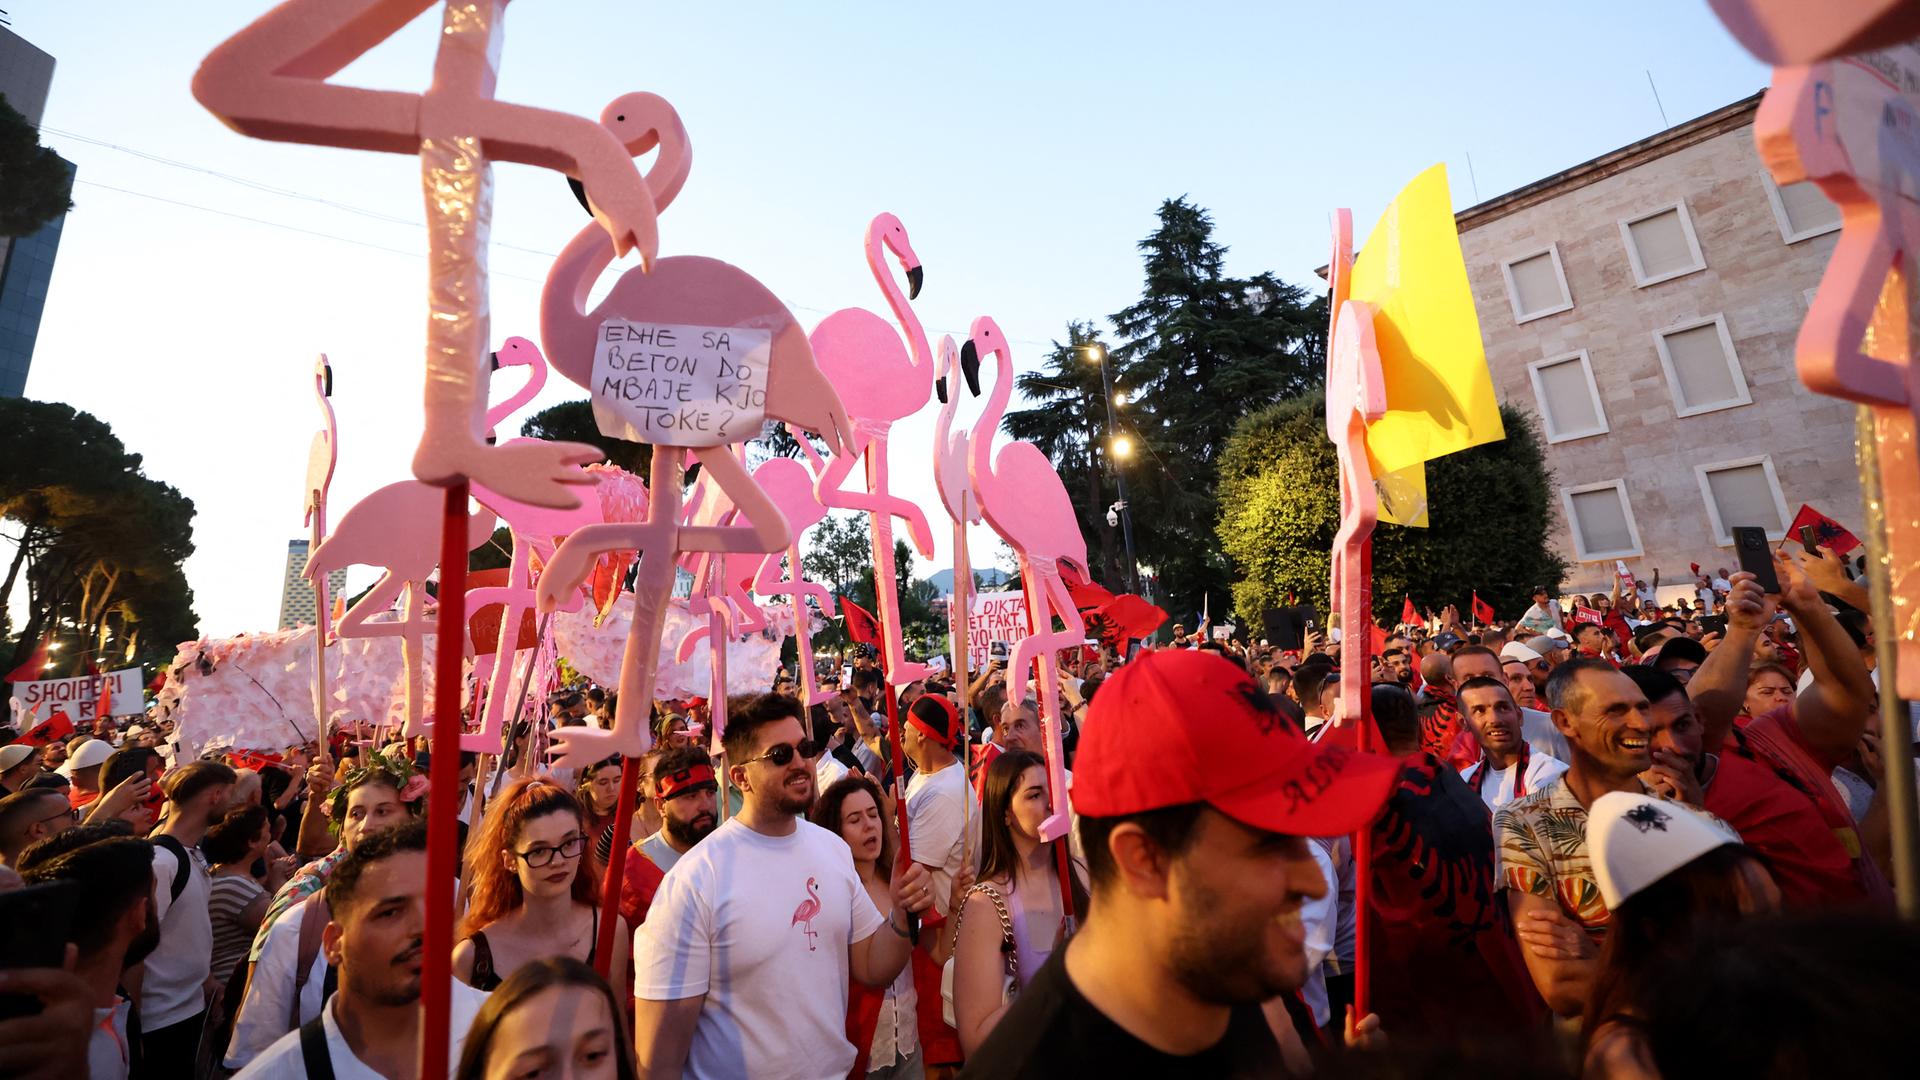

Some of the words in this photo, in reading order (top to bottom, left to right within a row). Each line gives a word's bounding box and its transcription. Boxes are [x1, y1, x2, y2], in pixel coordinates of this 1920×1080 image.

[605, 325, 677, 348] EDHE
[702, 331, 731, 352] SA
[608, 345, 697, 377] BETON
[717, 356, 752, 381] DO
[601, 376, 693, 402] MBAJE
[716, 383, 767, 410] KJO
